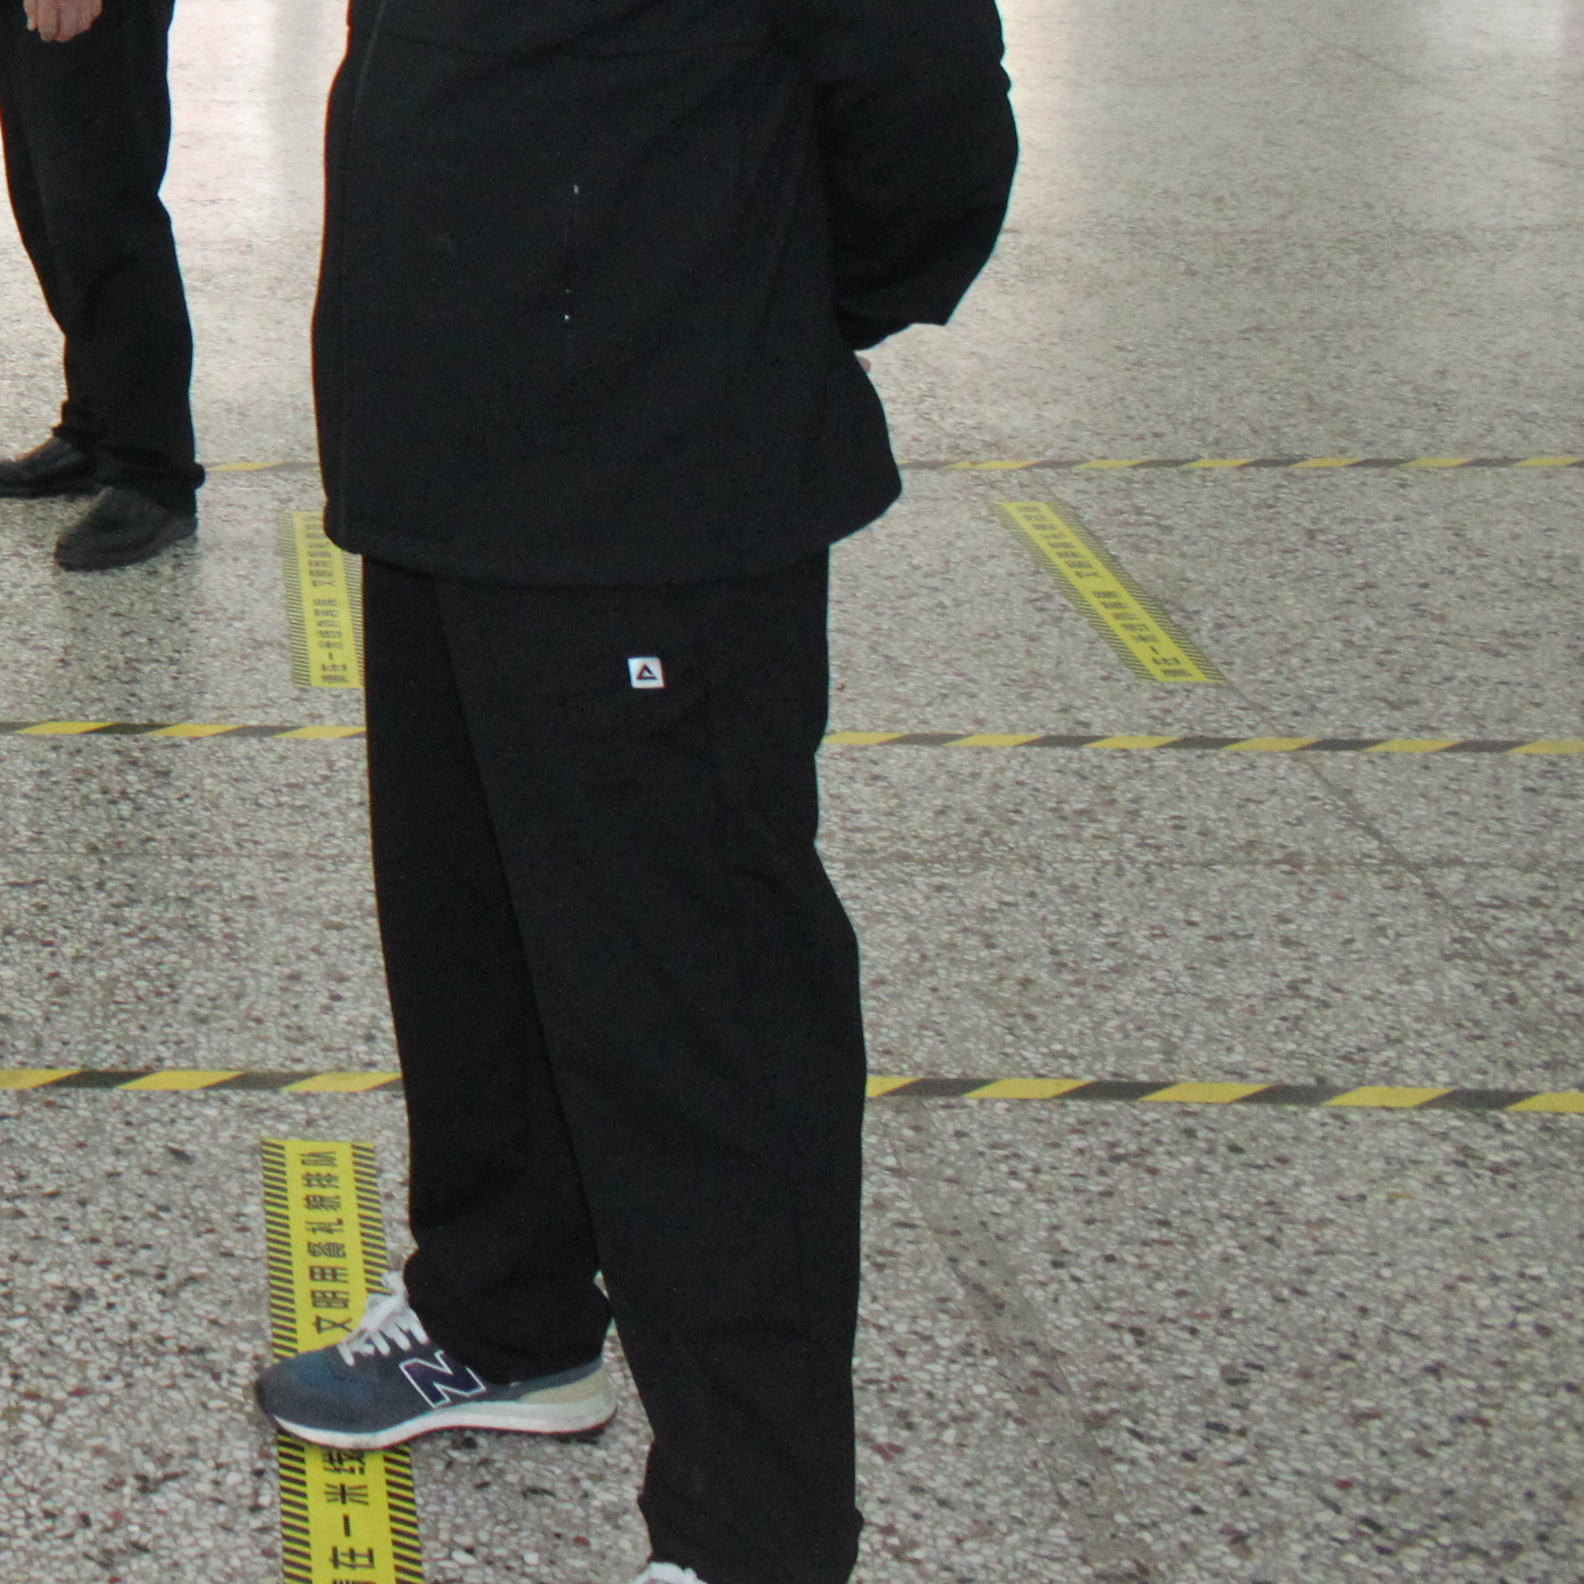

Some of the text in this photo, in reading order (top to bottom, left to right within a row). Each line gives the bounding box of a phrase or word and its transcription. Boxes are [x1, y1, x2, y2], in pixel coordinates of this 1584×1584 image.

[301, 1150, 352, 1334] 文明用餐礼貌排队
